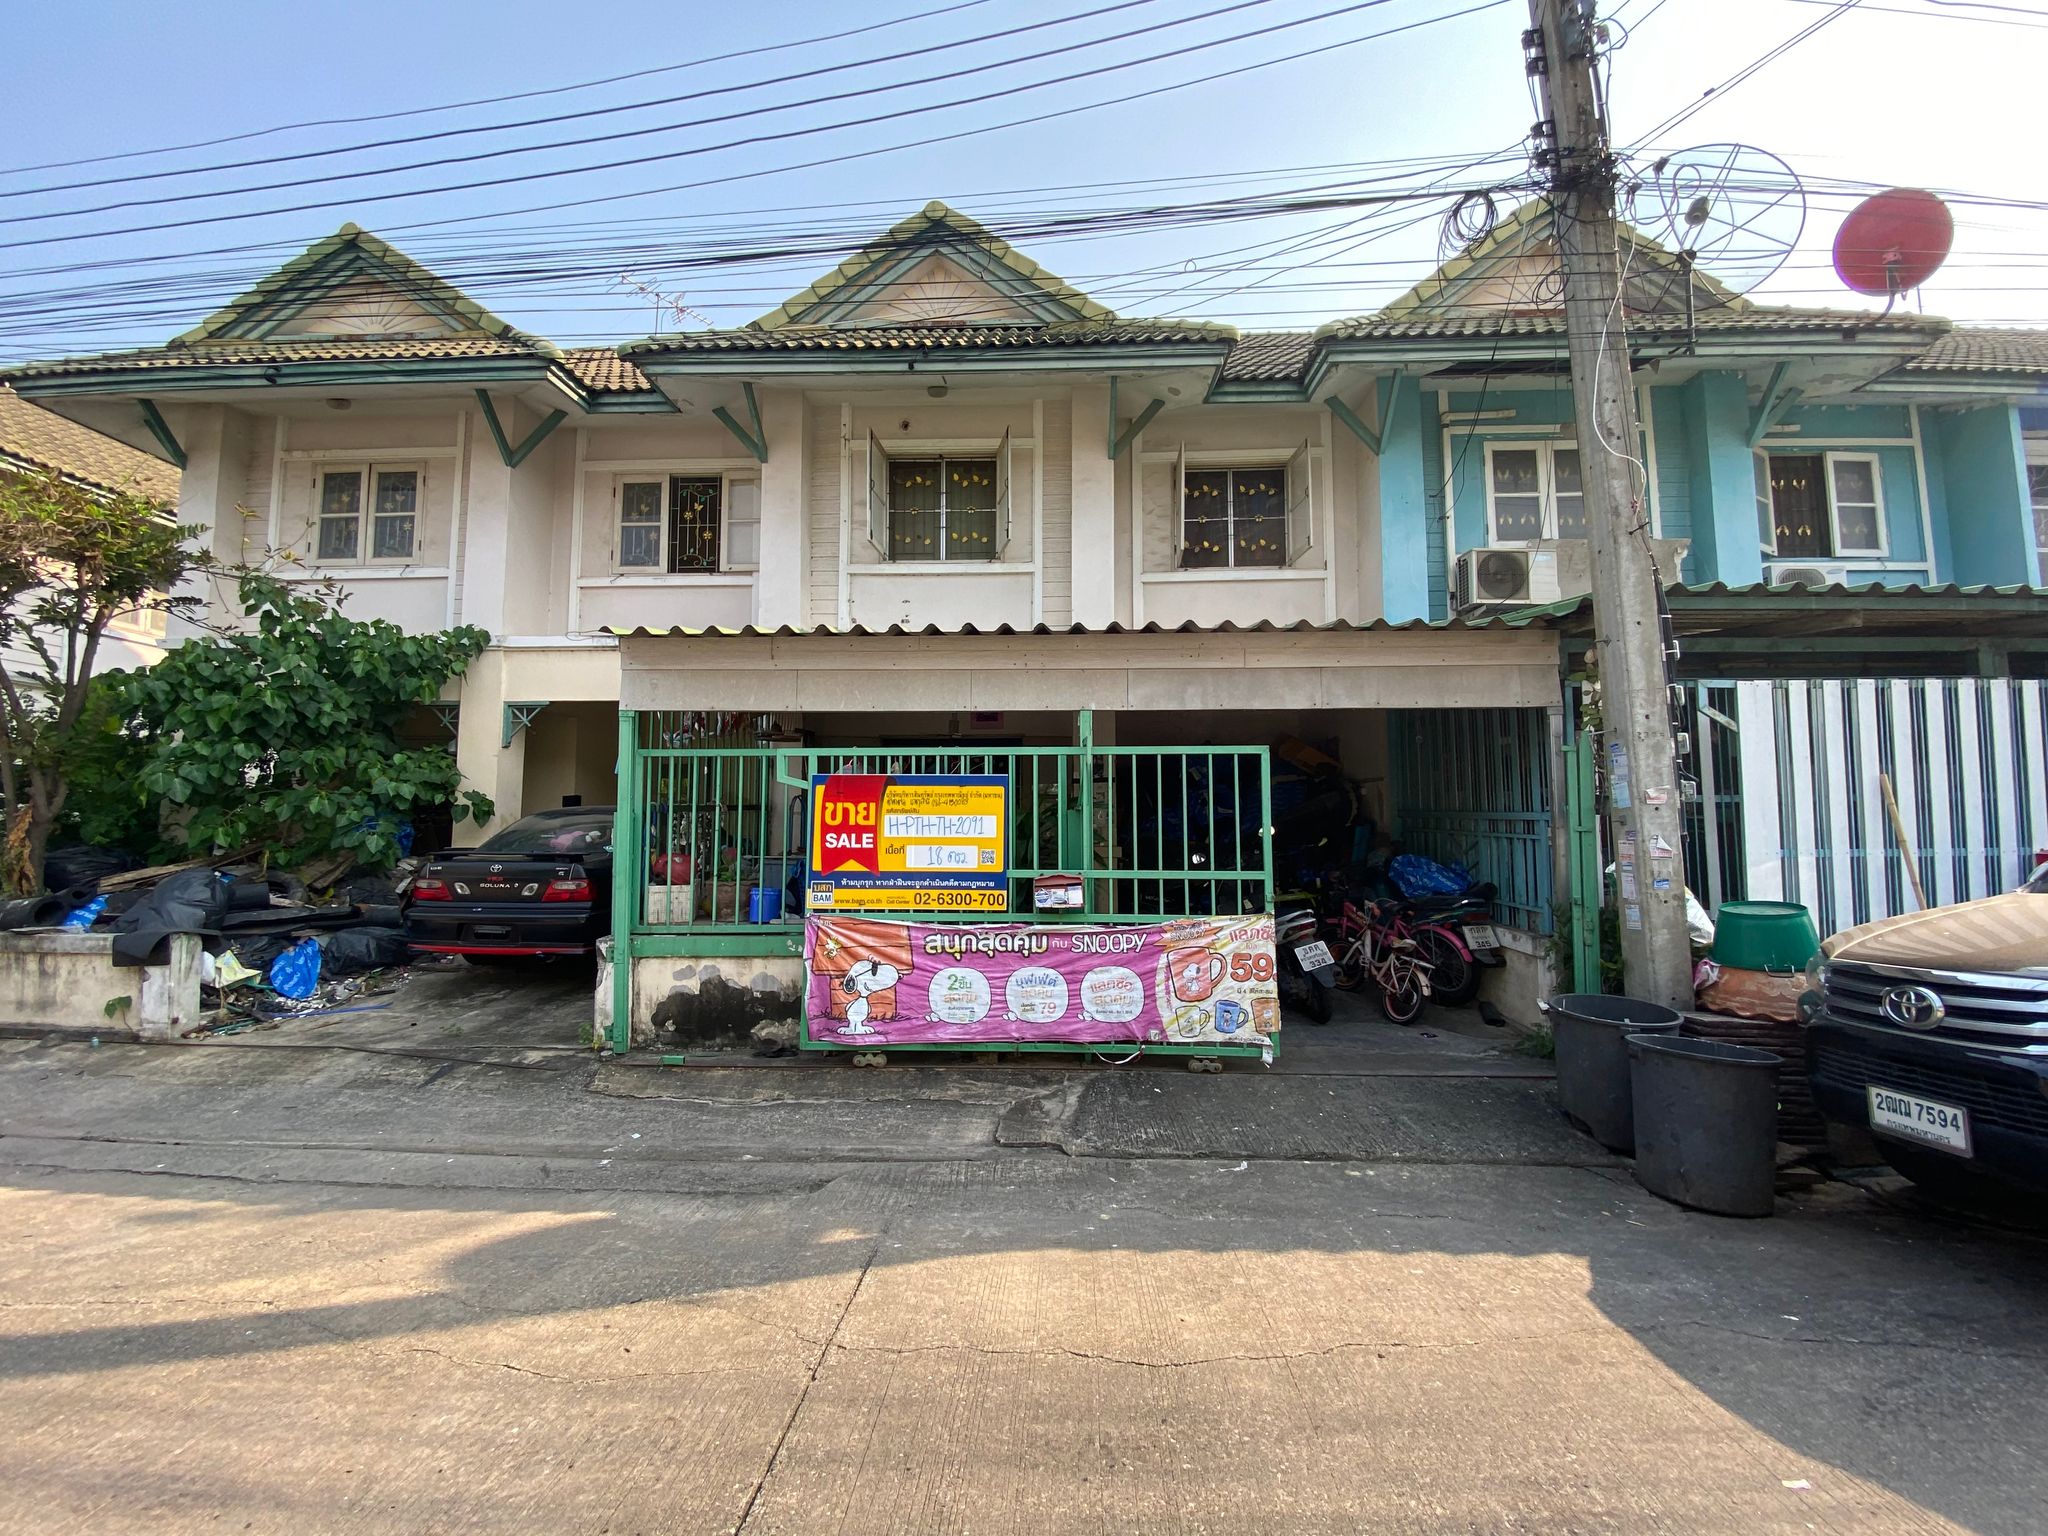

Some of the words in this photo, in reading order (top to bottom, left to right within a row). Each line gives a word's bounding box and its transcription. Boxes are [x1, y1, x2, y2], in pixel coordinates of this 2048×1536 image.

[825, 801, 876, 826] ขาย
[889, 816, 984, 836] H-PTH-TH-2091
[825, 833, 874, 848] SALE
[885, 844, 905, 855] เนื้อที่
[927, 846, 943, 866] 18
[814, 883, 832, 892] บสก
[841, 878, 873, 889] ห้ามบุกรุก
[813, 893, 832, 903] BAM
[834, 898, 882, 906] www.bam.co.th
[914, 893, 1005, 906] 02-6300-700
[924, 933, 1048, 960] สนุกสุดคุ้ม
[1052, 938, 1068, 949] กับ
[1071, 933, 1148, 954] SNOOPY
[1309, 957, 1327, 968] 334
[1039, 1002, 1057, 1014] 79
[1914, 1103, 1960, 1132] 7594
